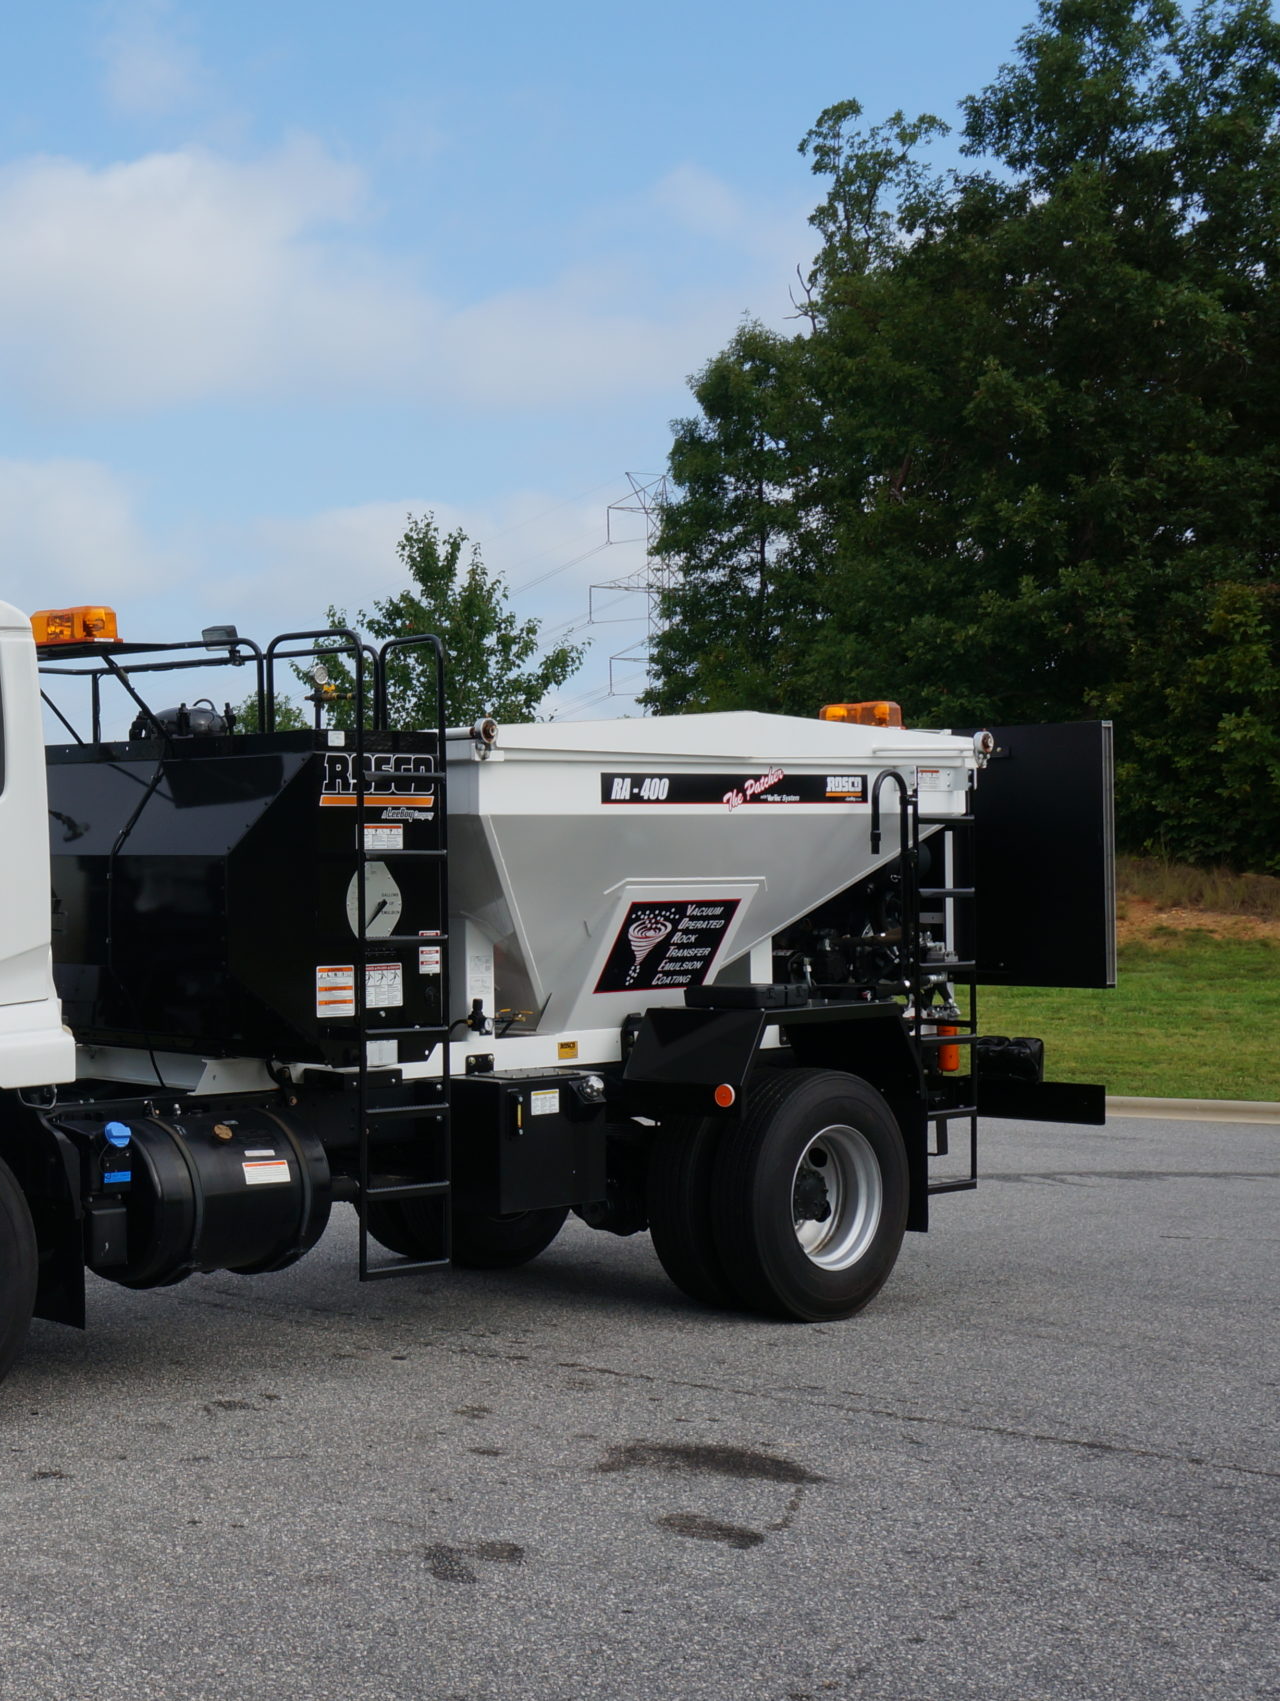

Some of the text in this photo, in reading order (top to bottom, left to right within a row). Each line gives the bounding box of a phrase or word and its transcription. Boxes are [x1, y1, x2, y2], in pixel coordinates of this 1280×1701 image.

[722, 766, 784, 812] The Patcher
[826, 777, 862, 792] ROSCO
[686, 904, 724, 916] VACUUM
[678, 918, 725, 929] OPERATED
[670, 932, 699, 943] ROCK
[666, 946, 711, 957] TRANSFER
[658, 959, 703, 971] EMULSION
[651, 974, 691, 985] COATING
